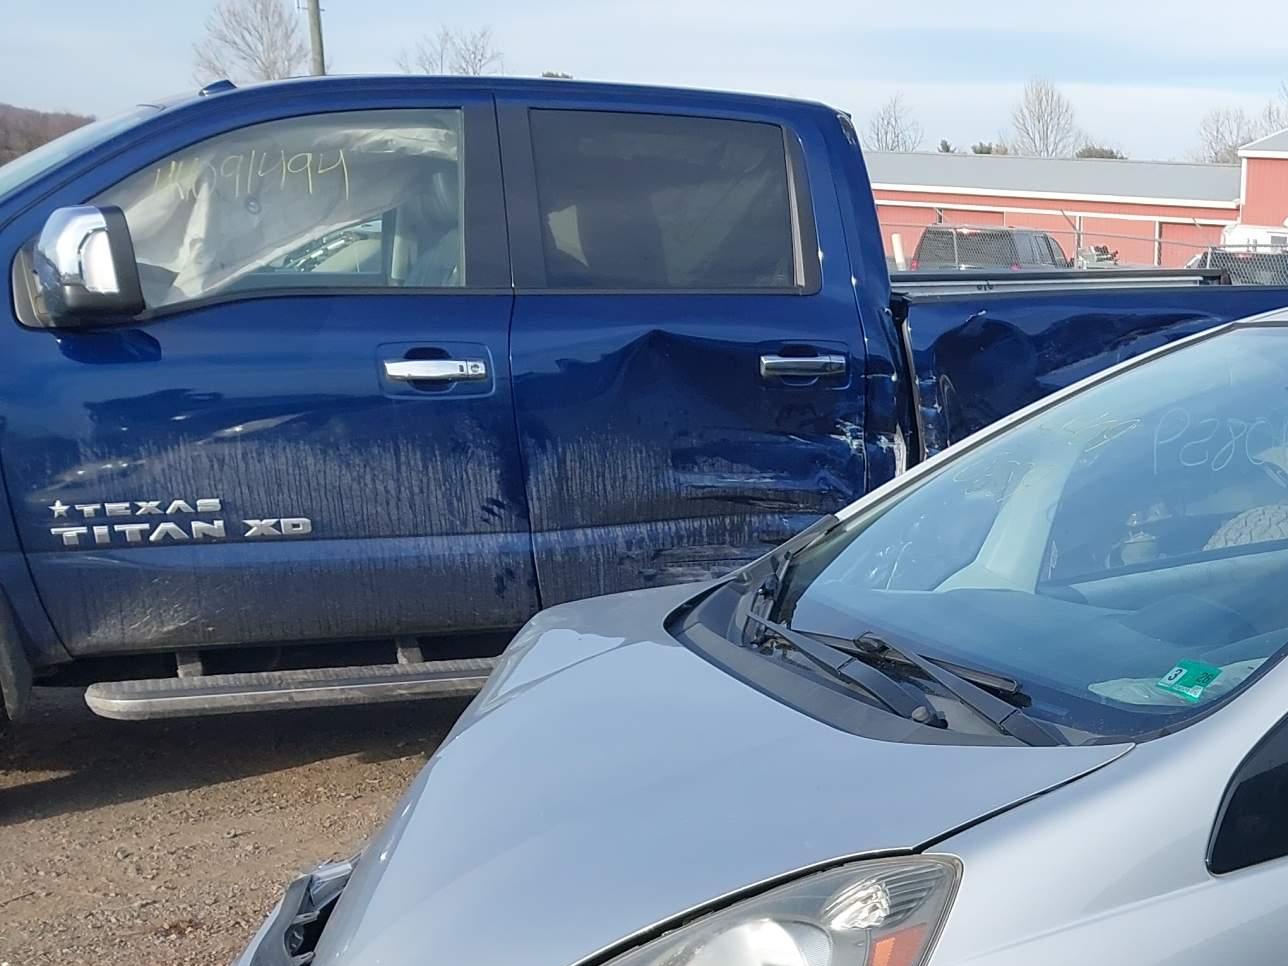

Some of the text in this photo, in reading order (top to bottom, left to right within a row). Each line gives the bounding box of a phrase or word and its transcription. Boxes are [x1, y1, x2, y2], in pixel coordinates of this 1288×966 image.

[75, 498, 222, 518] TEXAS
[50, 517, 312, 546] TITAN XD
[1168, 669, 1183, 681] 3
